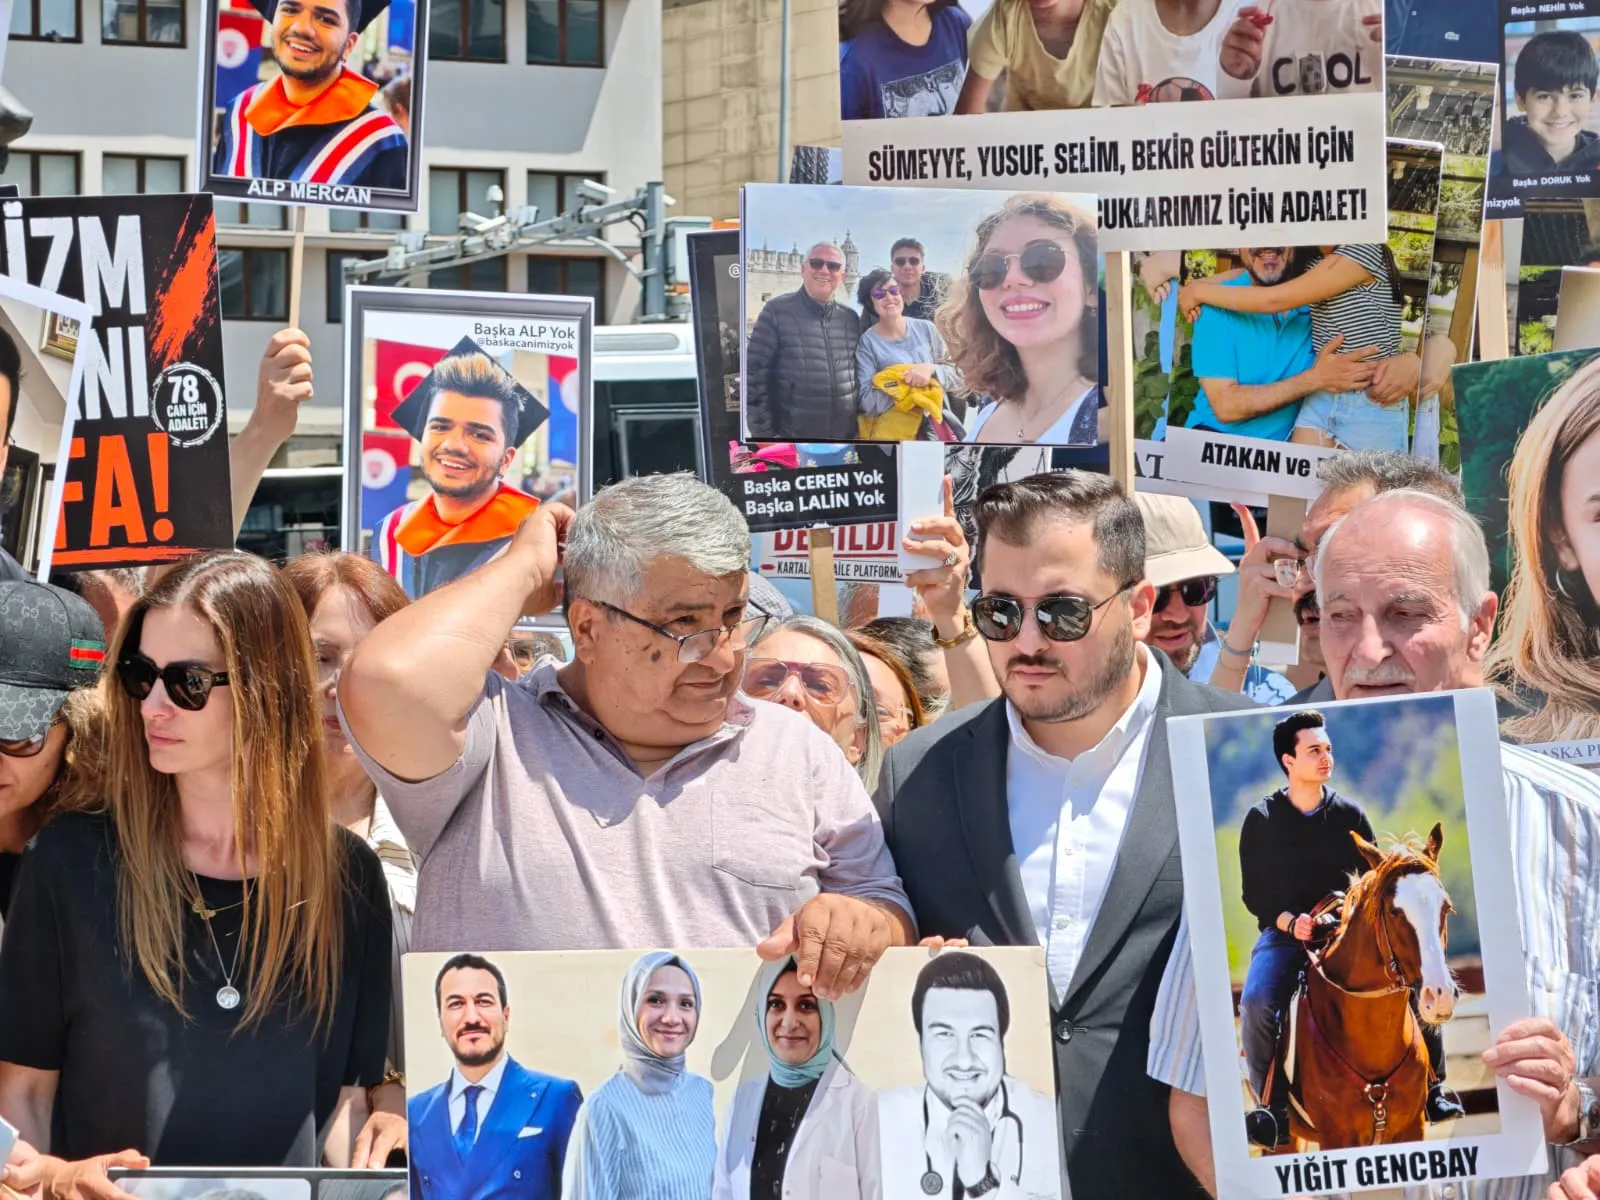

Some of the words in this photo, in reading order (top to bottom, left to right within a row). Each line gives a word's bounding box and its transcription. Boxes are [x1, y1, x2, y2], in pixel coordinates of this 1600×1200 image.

[1511, 7, 1536, 15] Başka
[1569, 2, 1584, 10] Yok
[869, 145, 972, 181] SÜMEYYE,
[978, 144, 1048, 177] YUSUF,
[1054, 137, 1125, 175] SELİM,
[1132, 132, 1193, 171] BEKİR
[1200, 128, 1300, 168] GÜLTEKİN
[1307, 125, 1354, 169] İÇİN
[247, 180, 285, 197] ALP
[291, 185, 371, 204] MERCAN
[1512, 178, 1538, 188] Başka
[1575, 174, 1591, 183] Yok
[1228, 187, 1274, 230] İÇİN
[1280, 188, 1367, 224] ADALET!
[474, 322, 515, 337] Başka
[519, 325, 546, 337] ALP
[550, 326, 576, 339] Yok
[477, 337, 575, 351] @baskacanimizyok
[75, 326, 149, 420] NI
[167, 374, 200, 404] 78
[166, 403, 187, 418] CAN
[168, 417, 209, 432] ADALET!
[1201, 441, 1281, 474] ATAKAN
[1286, 456, 1311, 477] ve
[744, 477, 792, 497] Başka
[795, 472, 849, 491] CEREN
[853, 468, 885, 487] Yok
[745, 497, 794, 516] Başka
[799, 490, 850, 513] LALİN
[854, 491, 886, 508] Yok
[1274, 1155, 1347, 1194] YİĞİT
[1356, 1146, 1479, 1187] GENCBAY
